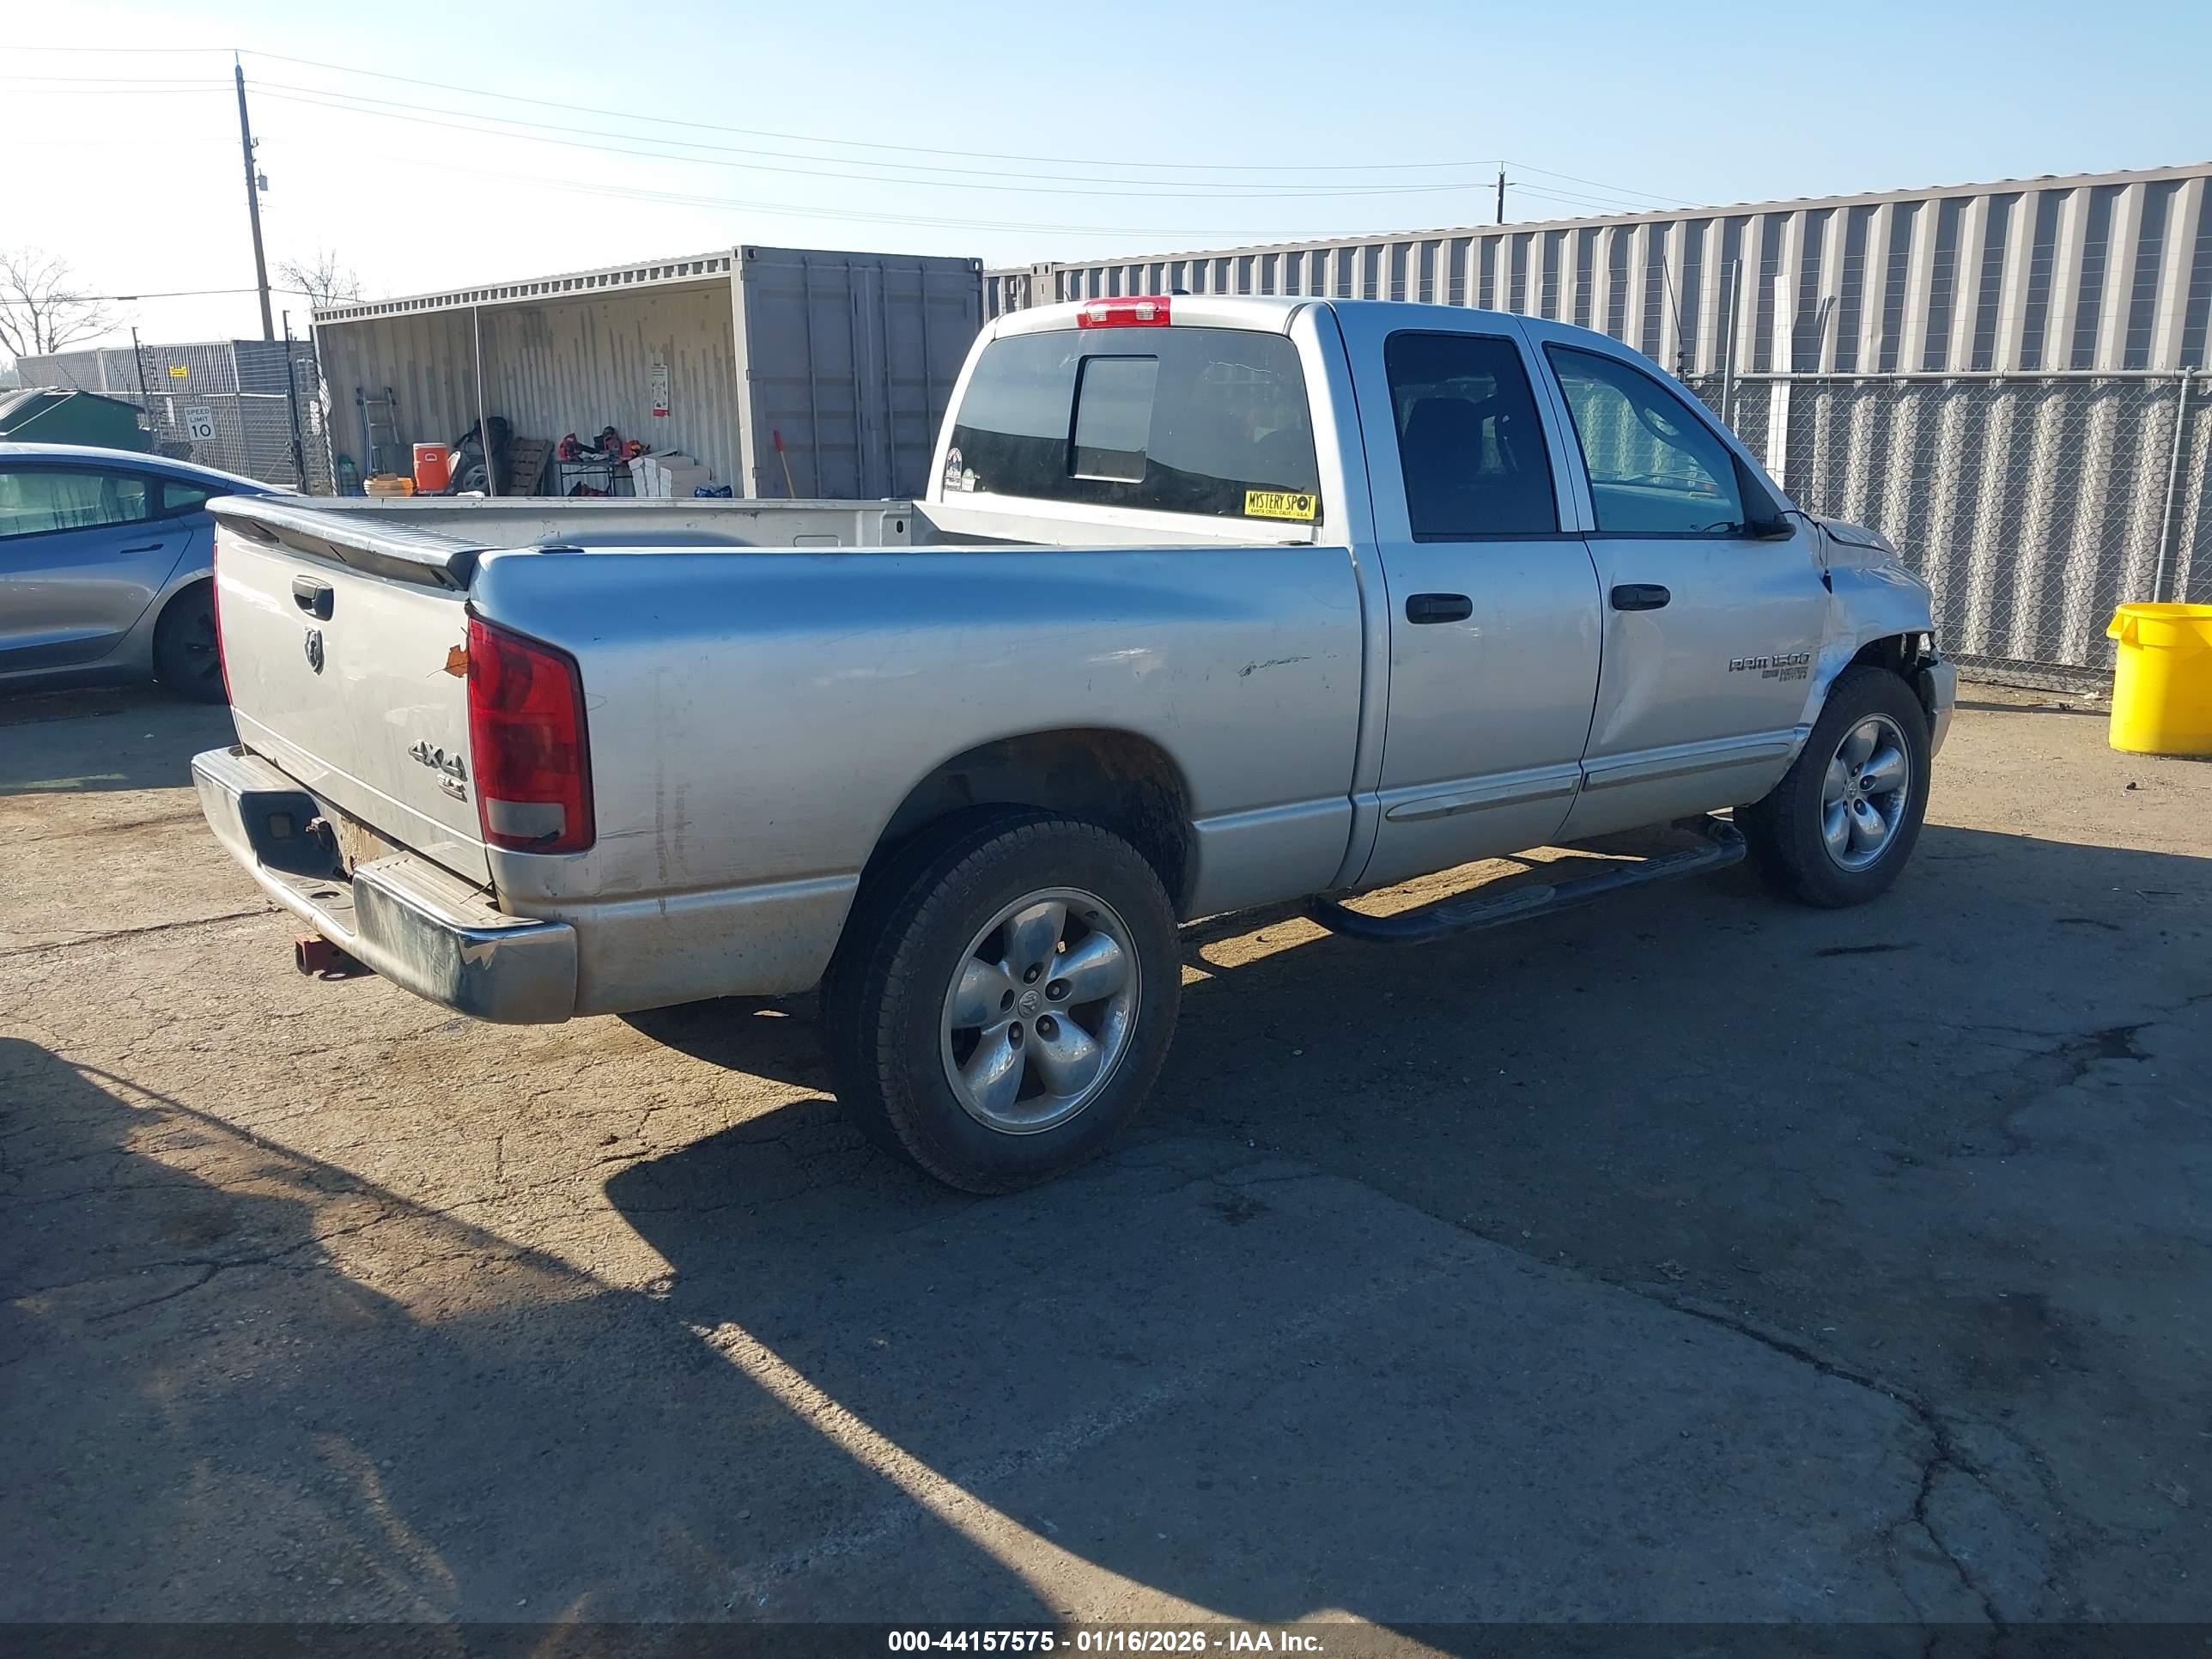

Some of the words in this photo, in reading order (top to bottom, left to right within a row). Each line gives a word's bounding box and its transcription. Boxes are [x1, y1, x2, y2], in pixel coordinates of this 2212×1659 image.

[191, 424, 211, 438] 10
[1249, 492, 1285, 510] MYSTERY
[1285, 495, 1313, 513] SPOT
[1729, 657, 1769, 672] RAM
[1772, 653, 1810, 667] 1500
